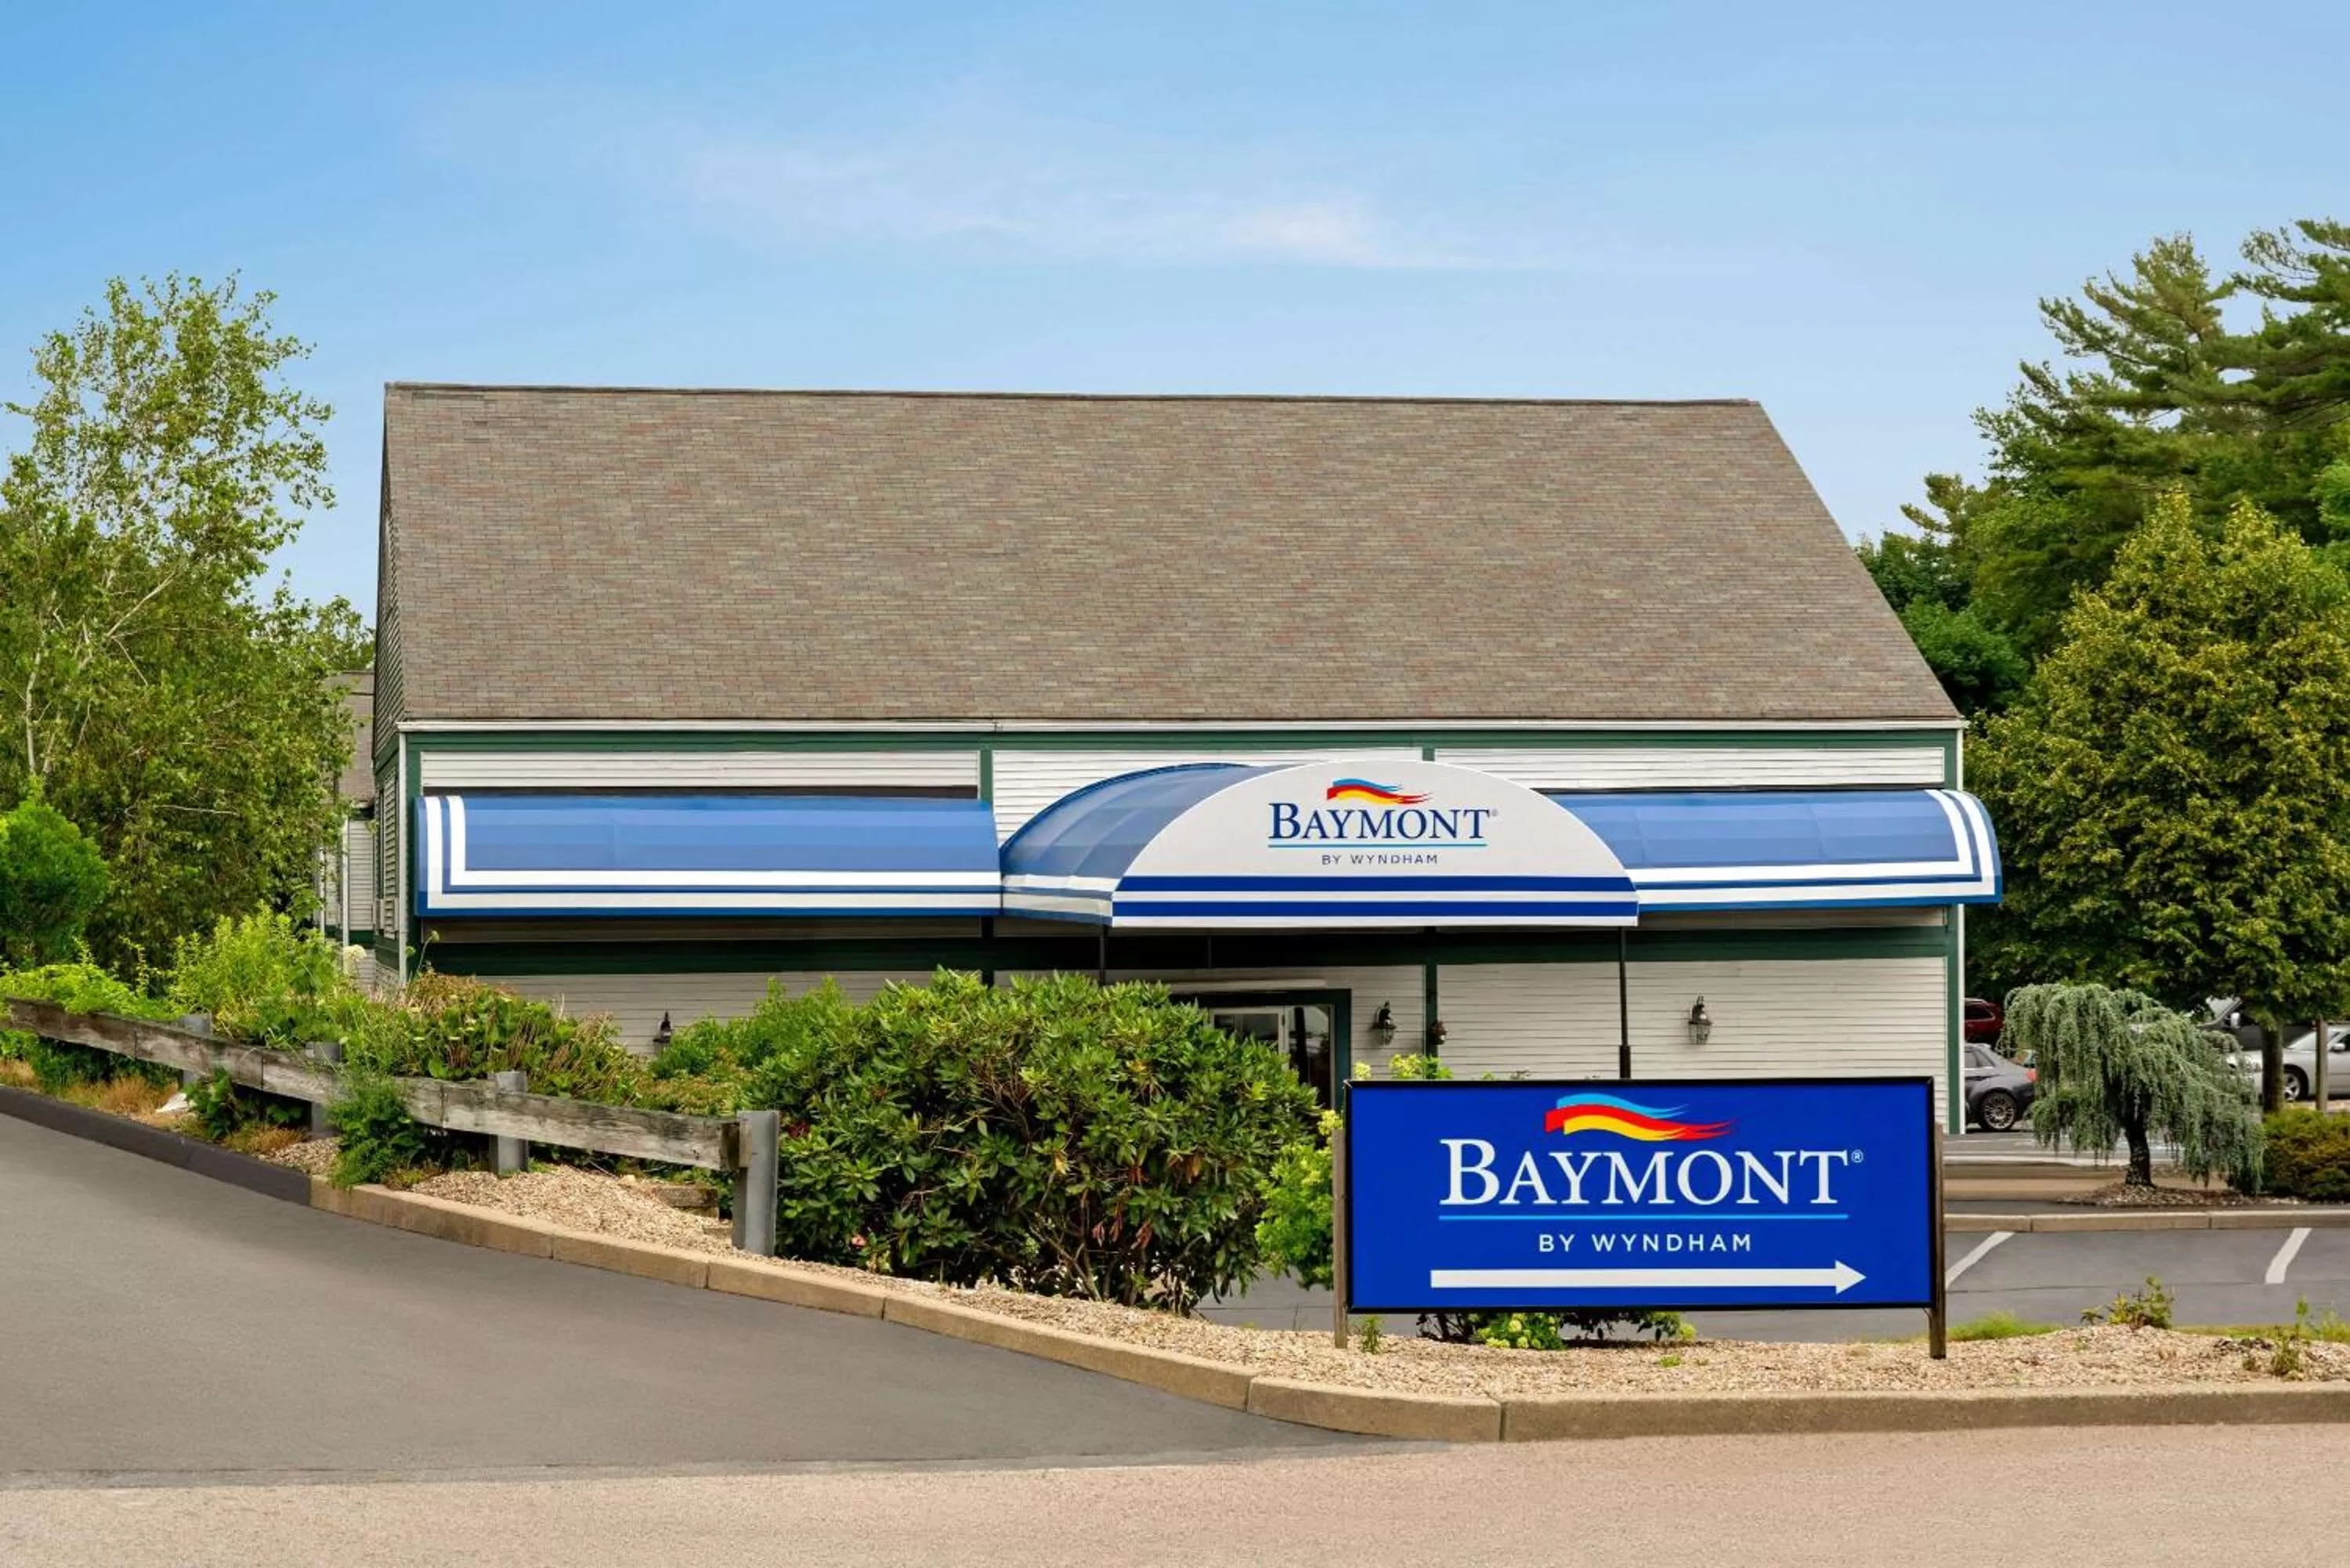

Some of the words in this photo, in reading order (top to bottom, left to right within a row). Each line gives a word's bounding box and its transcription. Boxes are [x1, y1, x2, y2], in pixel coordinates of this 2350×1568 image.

[1268, 802, 1491, 840] BAYMONT
[1321, 854, 1341, 865] BY
[1350, 854, 1438, 865] WYNDHAM
[1439, 1138, 1849, 1205] BAYMONT
[1538, 1234, 1575, 1252] BY
[1591, 1234, 1751, 1252] WYNDHAM
